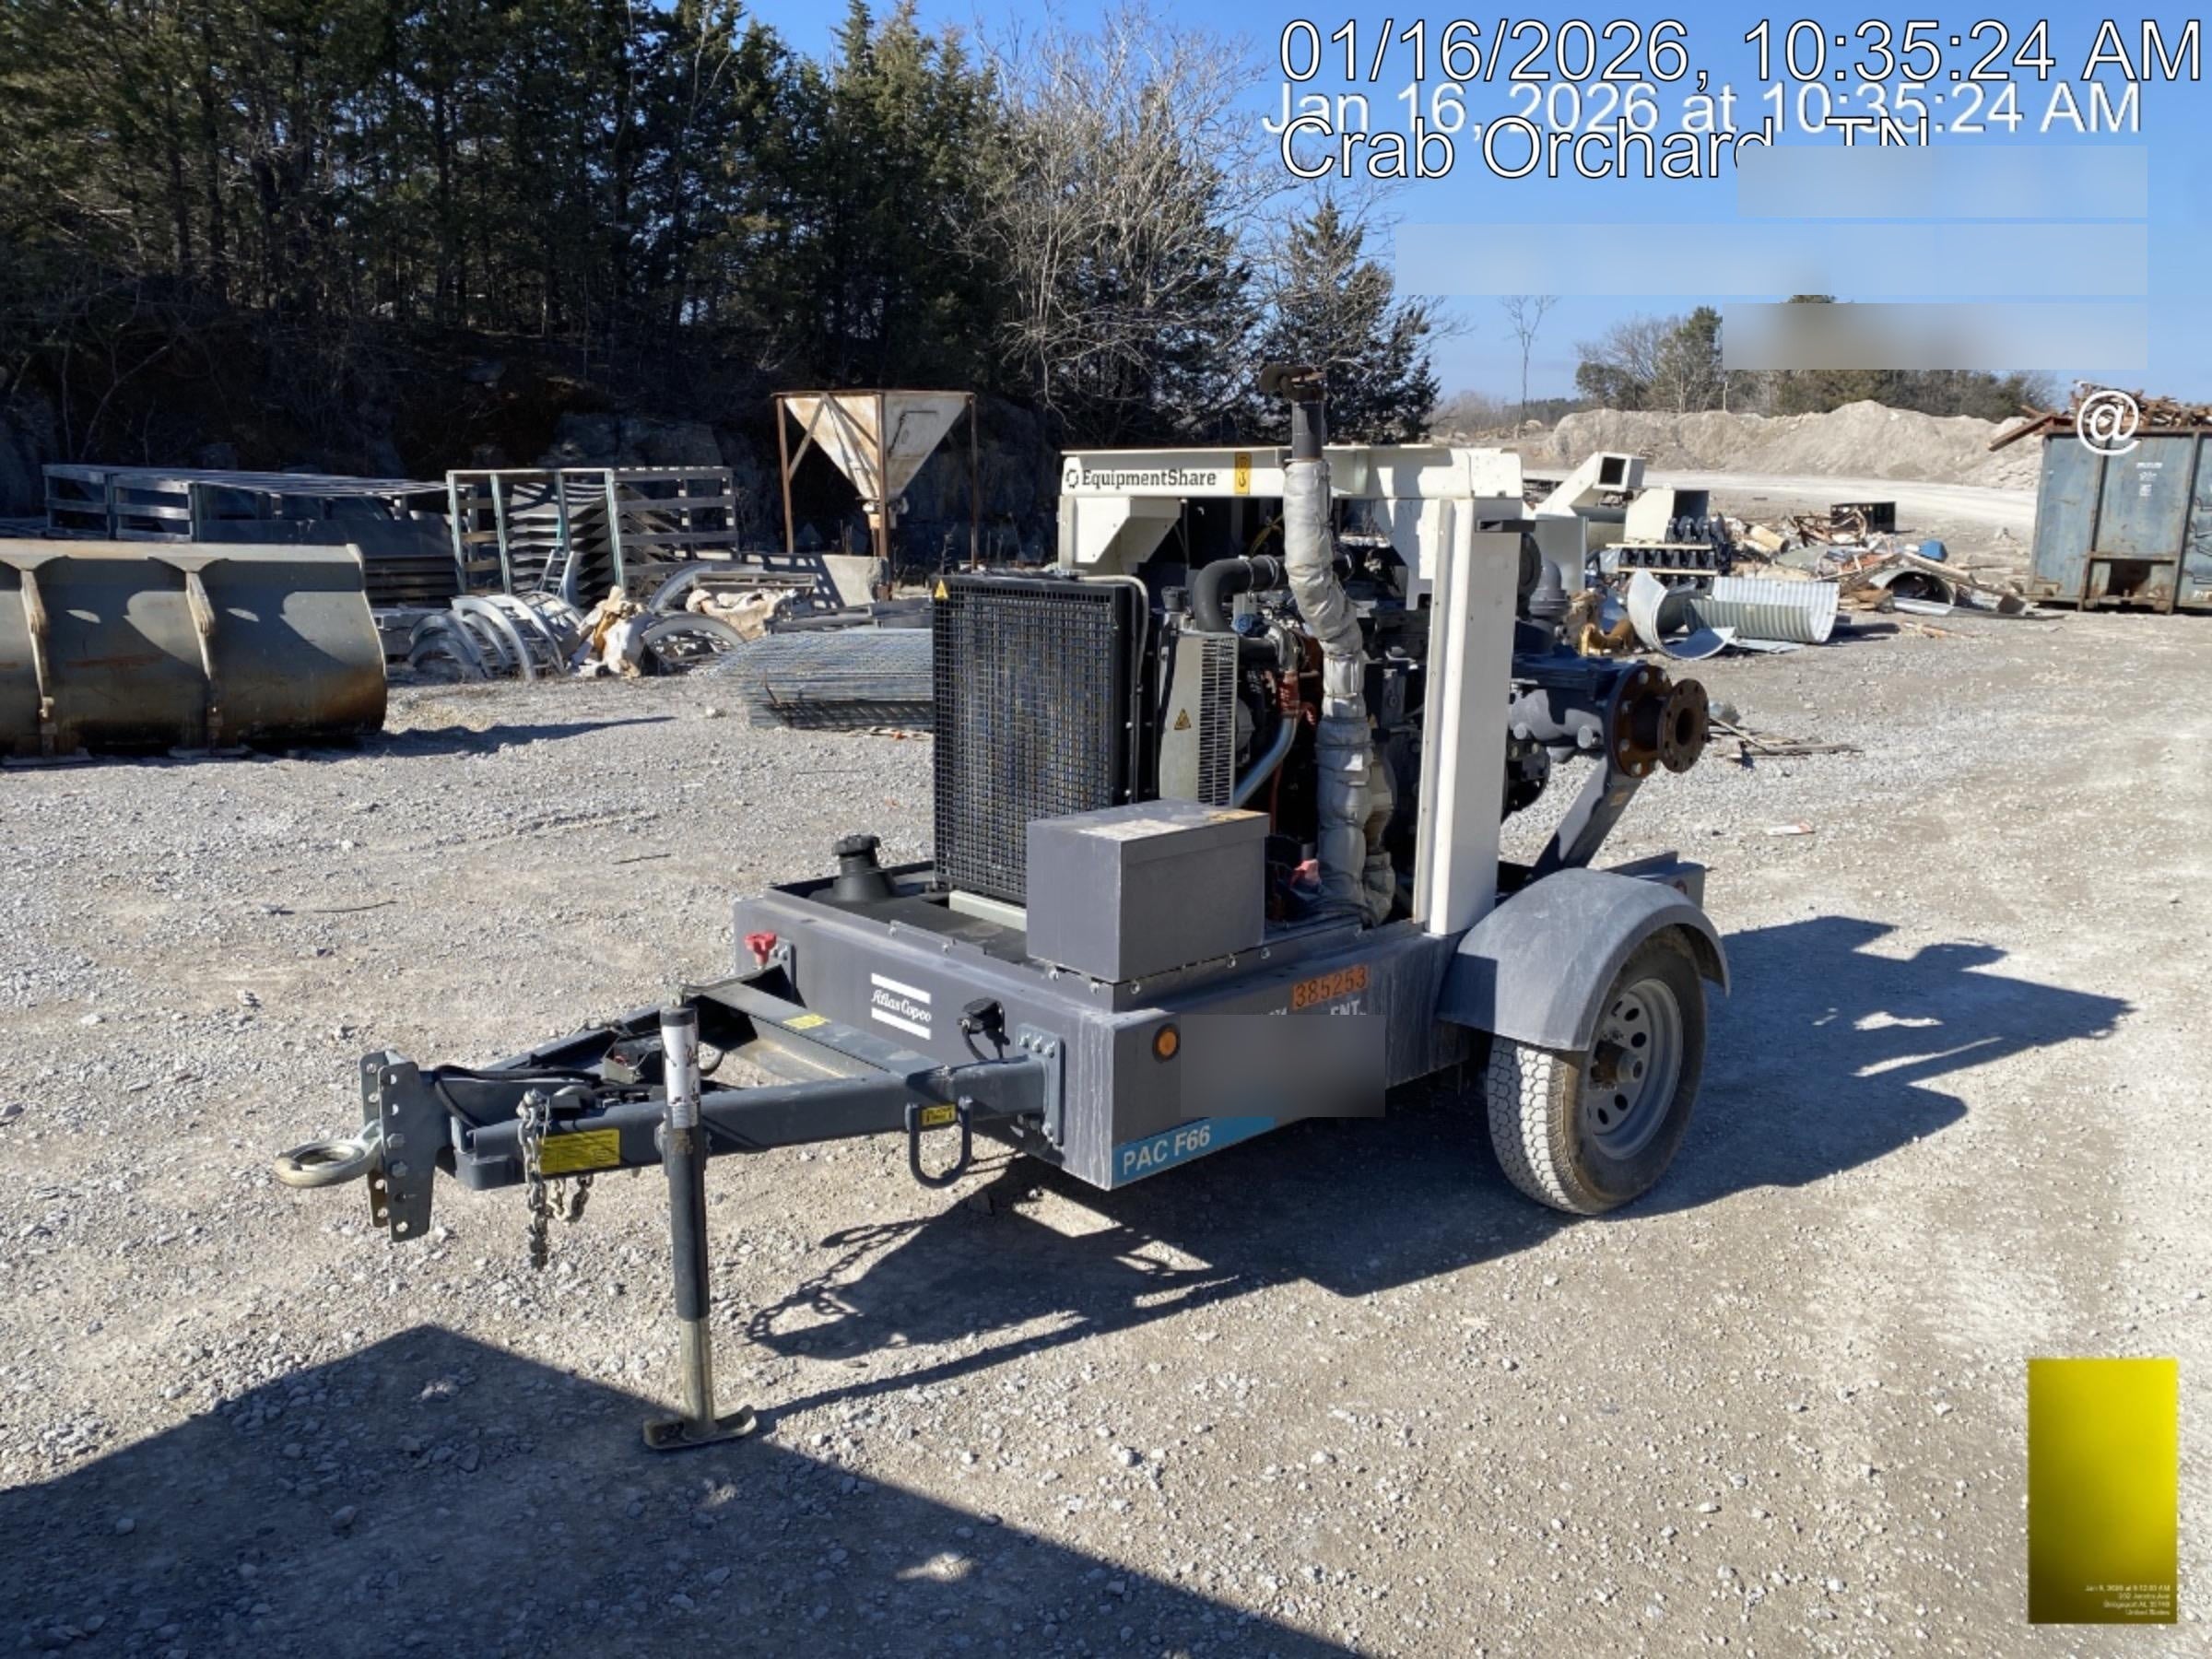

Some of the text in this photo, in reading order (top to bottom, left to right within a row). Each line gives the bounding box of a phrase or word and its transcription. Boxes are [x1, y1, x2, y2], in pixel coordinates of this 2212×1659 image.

[1081, 468, 1217, 489] EquipmentShare
[870, 989, 932, 1022] Atlas Copco
[1294, 967, 1366, 1008] 385253
[1123, 1124, 1210, 1175] PAC F66
